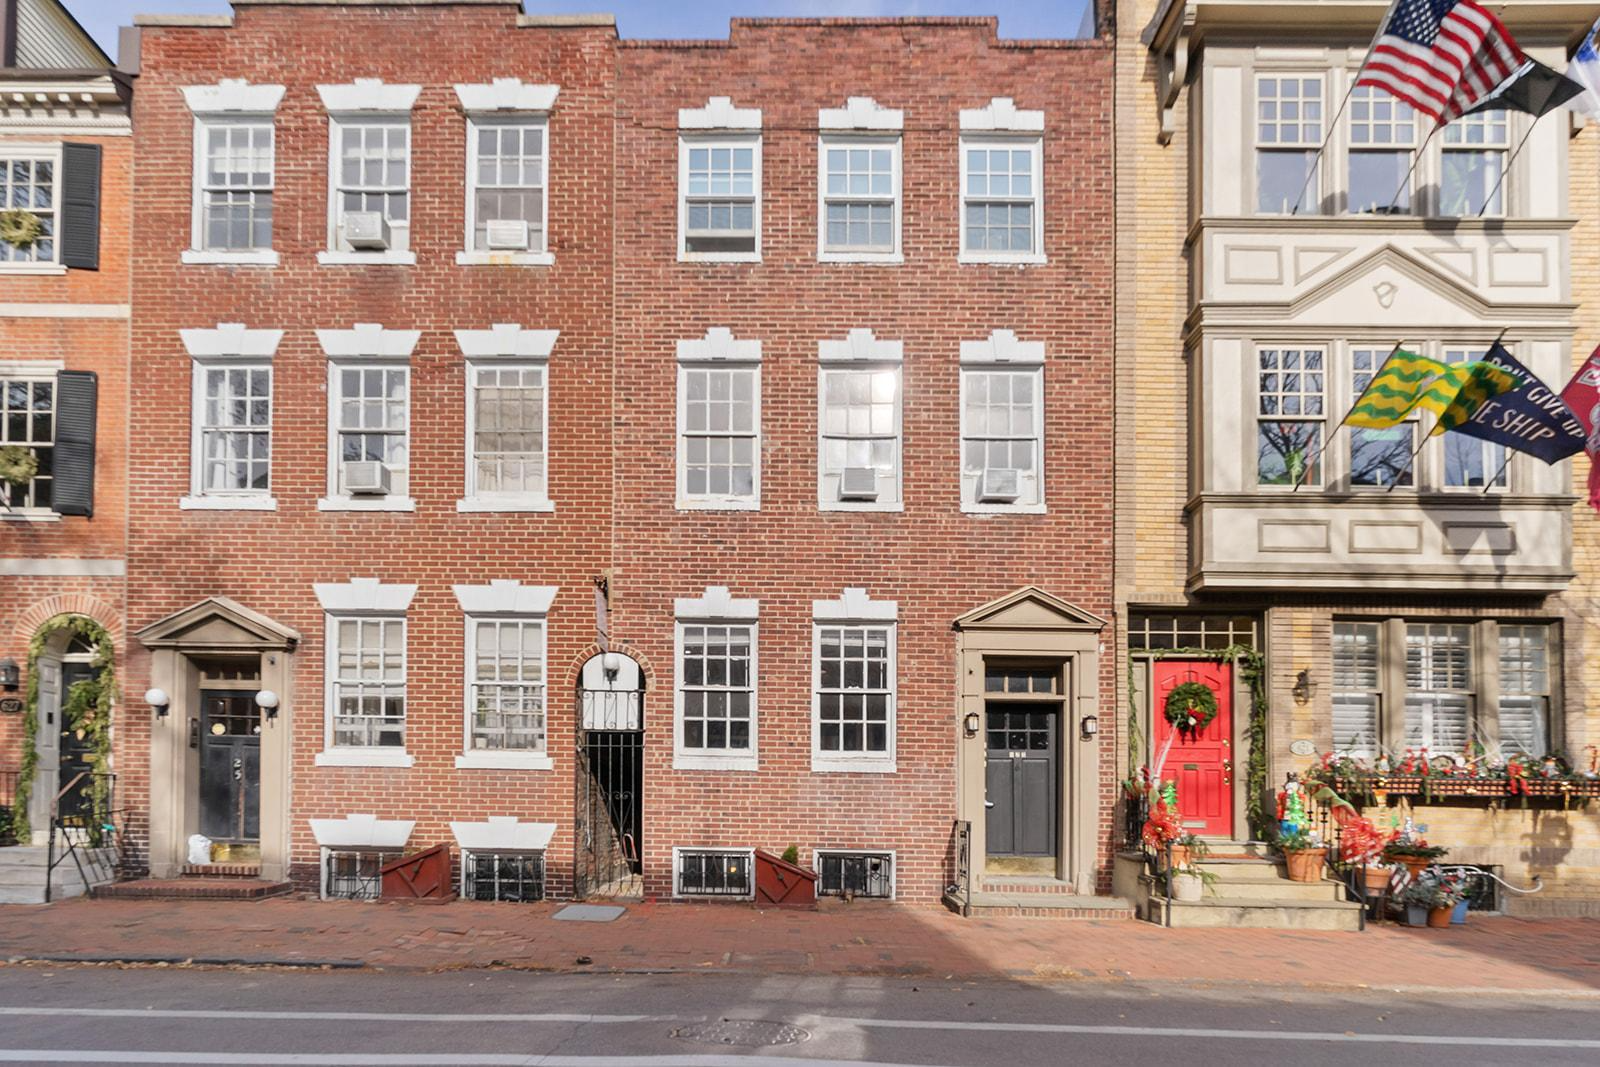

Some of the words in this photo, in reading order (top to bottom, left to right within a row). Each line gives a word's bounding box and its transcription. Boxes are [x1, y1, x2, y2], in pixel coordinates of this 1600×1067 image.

[1492, 409, 1555, 440] SHIP
[1527, 387, 1568, 419] GIVE
[1562, 420, 1585, 438] UP
